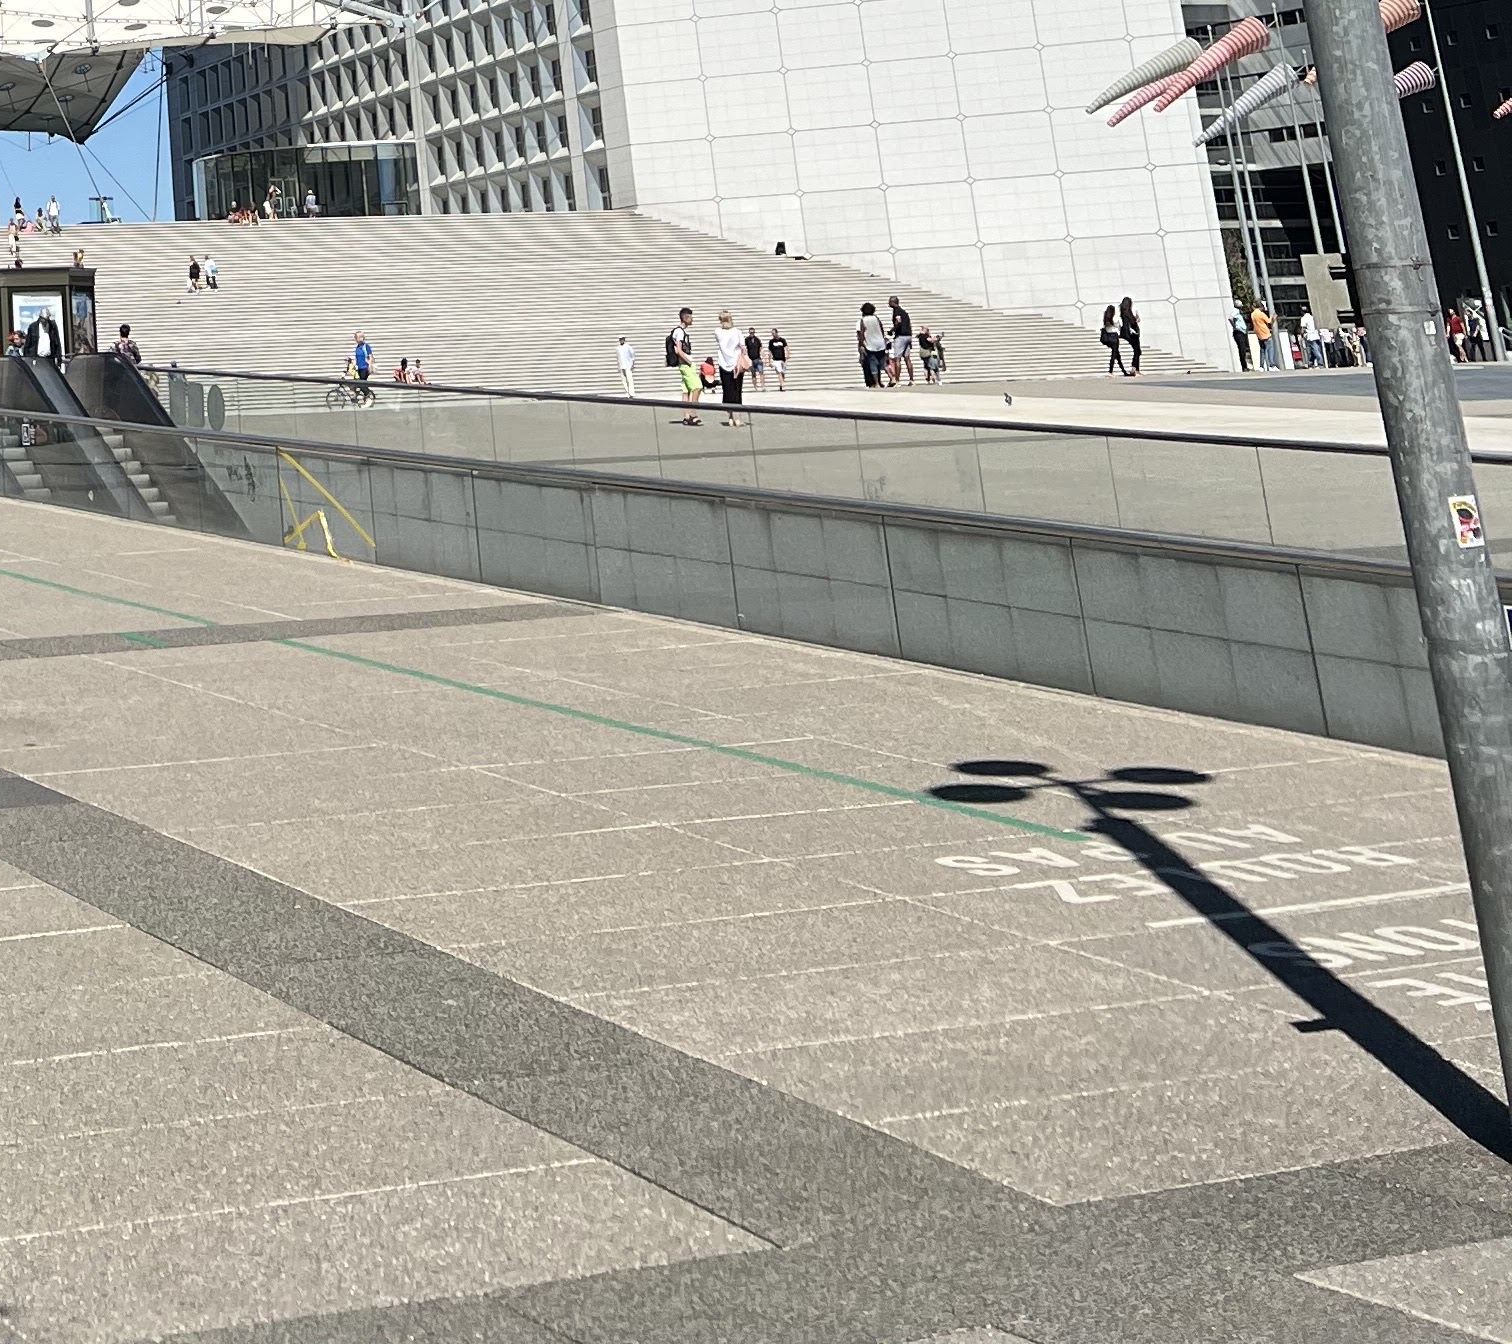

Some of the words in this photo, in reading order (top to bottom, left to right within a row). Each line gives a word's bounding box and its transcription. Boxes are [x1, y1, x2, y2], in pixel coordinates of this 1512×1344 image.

[1160, 823, 1302, 853] AU
[934, 840, 1150, 876] PAS
[1012, 845, 1415, 904] ROULEZ
